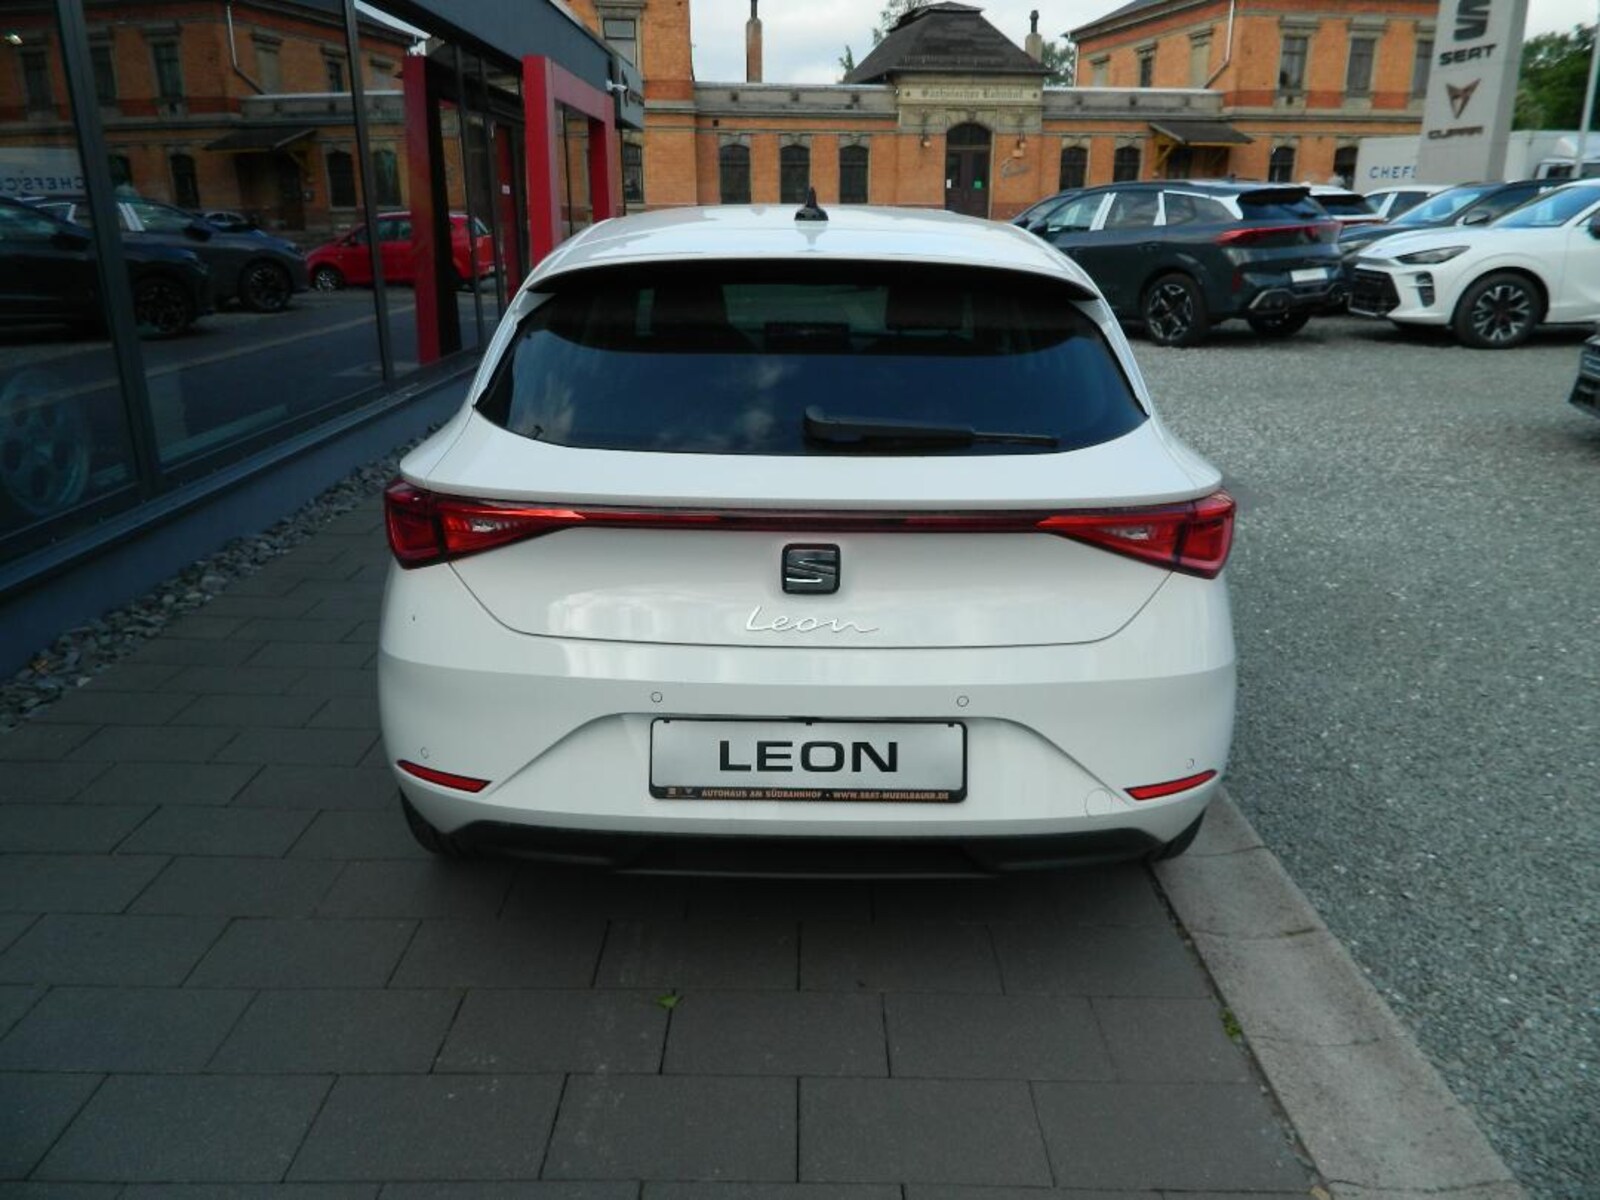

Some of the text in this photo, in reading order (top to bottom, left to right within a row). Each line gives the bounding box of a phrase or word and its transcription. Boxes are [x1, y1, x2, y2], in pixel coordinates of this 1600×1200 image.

[1439, 44, 1497, 66] SEAT
[745, 605, 880, 633] Leon
[719, 740, 898, 773] LEON
[701, 789, 747, 798] AUTOHAUS
[749, 790, 763, 798] AM
